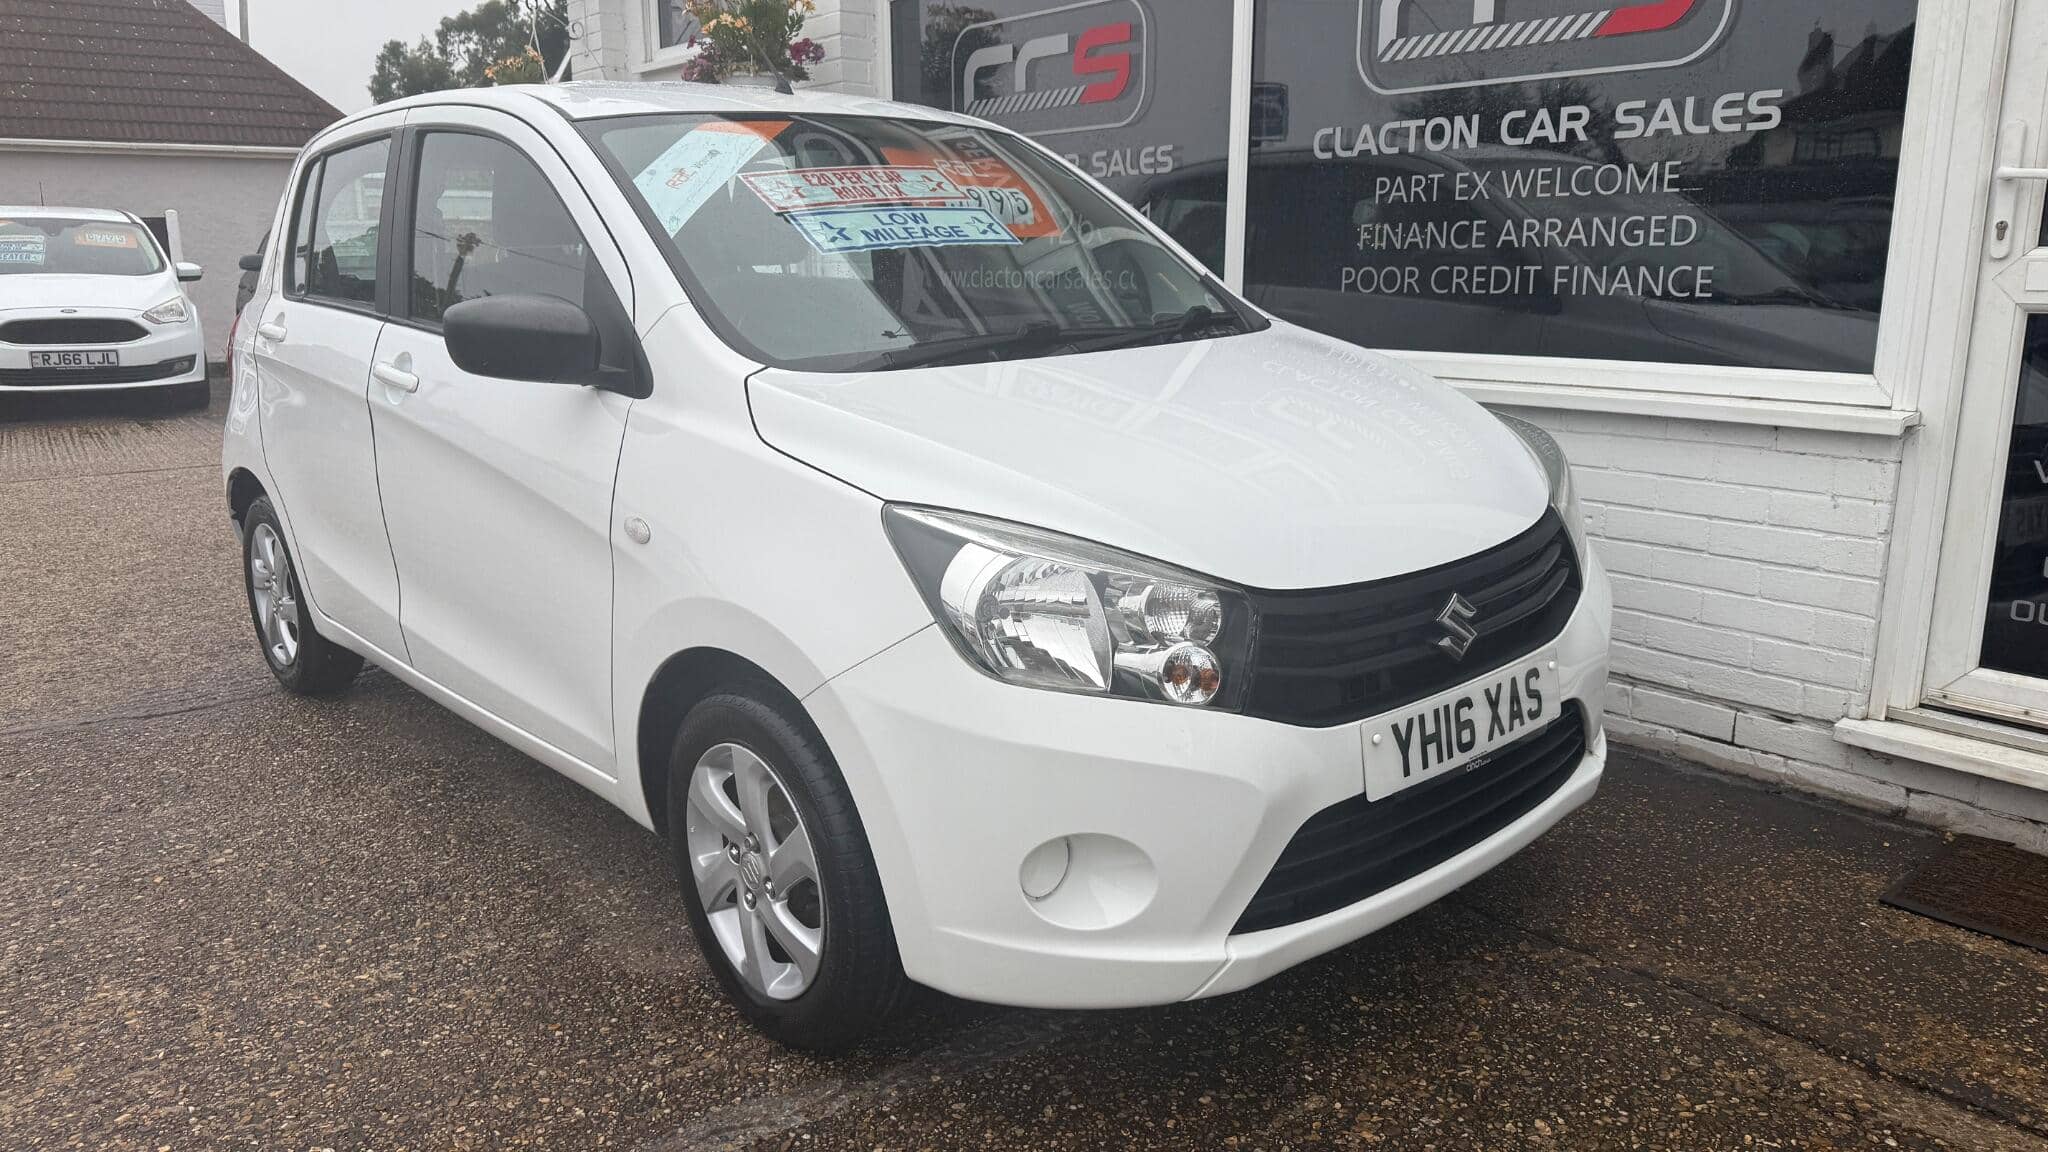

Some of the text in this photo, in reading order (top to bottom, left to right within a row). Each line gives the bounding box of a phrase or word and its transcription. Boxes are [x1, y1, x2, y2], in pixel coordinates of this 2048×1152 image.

[1313, 88, 1784, 160] CLACTON CAR SALES
[1091, 144, 1174, 178] SALES
[801, 169, 908, 187] £20 PER YEAR
[831, 183, 908, 200] ROAD TAX
[1375, 160, 1682, 204] PART EX WELCOME
[949, 188, 1029, 215] 995
[860, 226, 970, 242] MILEAGE
[873, 212, 929, 226] LOW
[1359, 214, 1697, 250] FINANCE ARRANGED
[1341, 265, 1714, 298] POOR CREDIT FINANCE
[41, 352, 117, 366] RJ66 LJL
[1391, 667, 1543, 777] YH16 XAS
